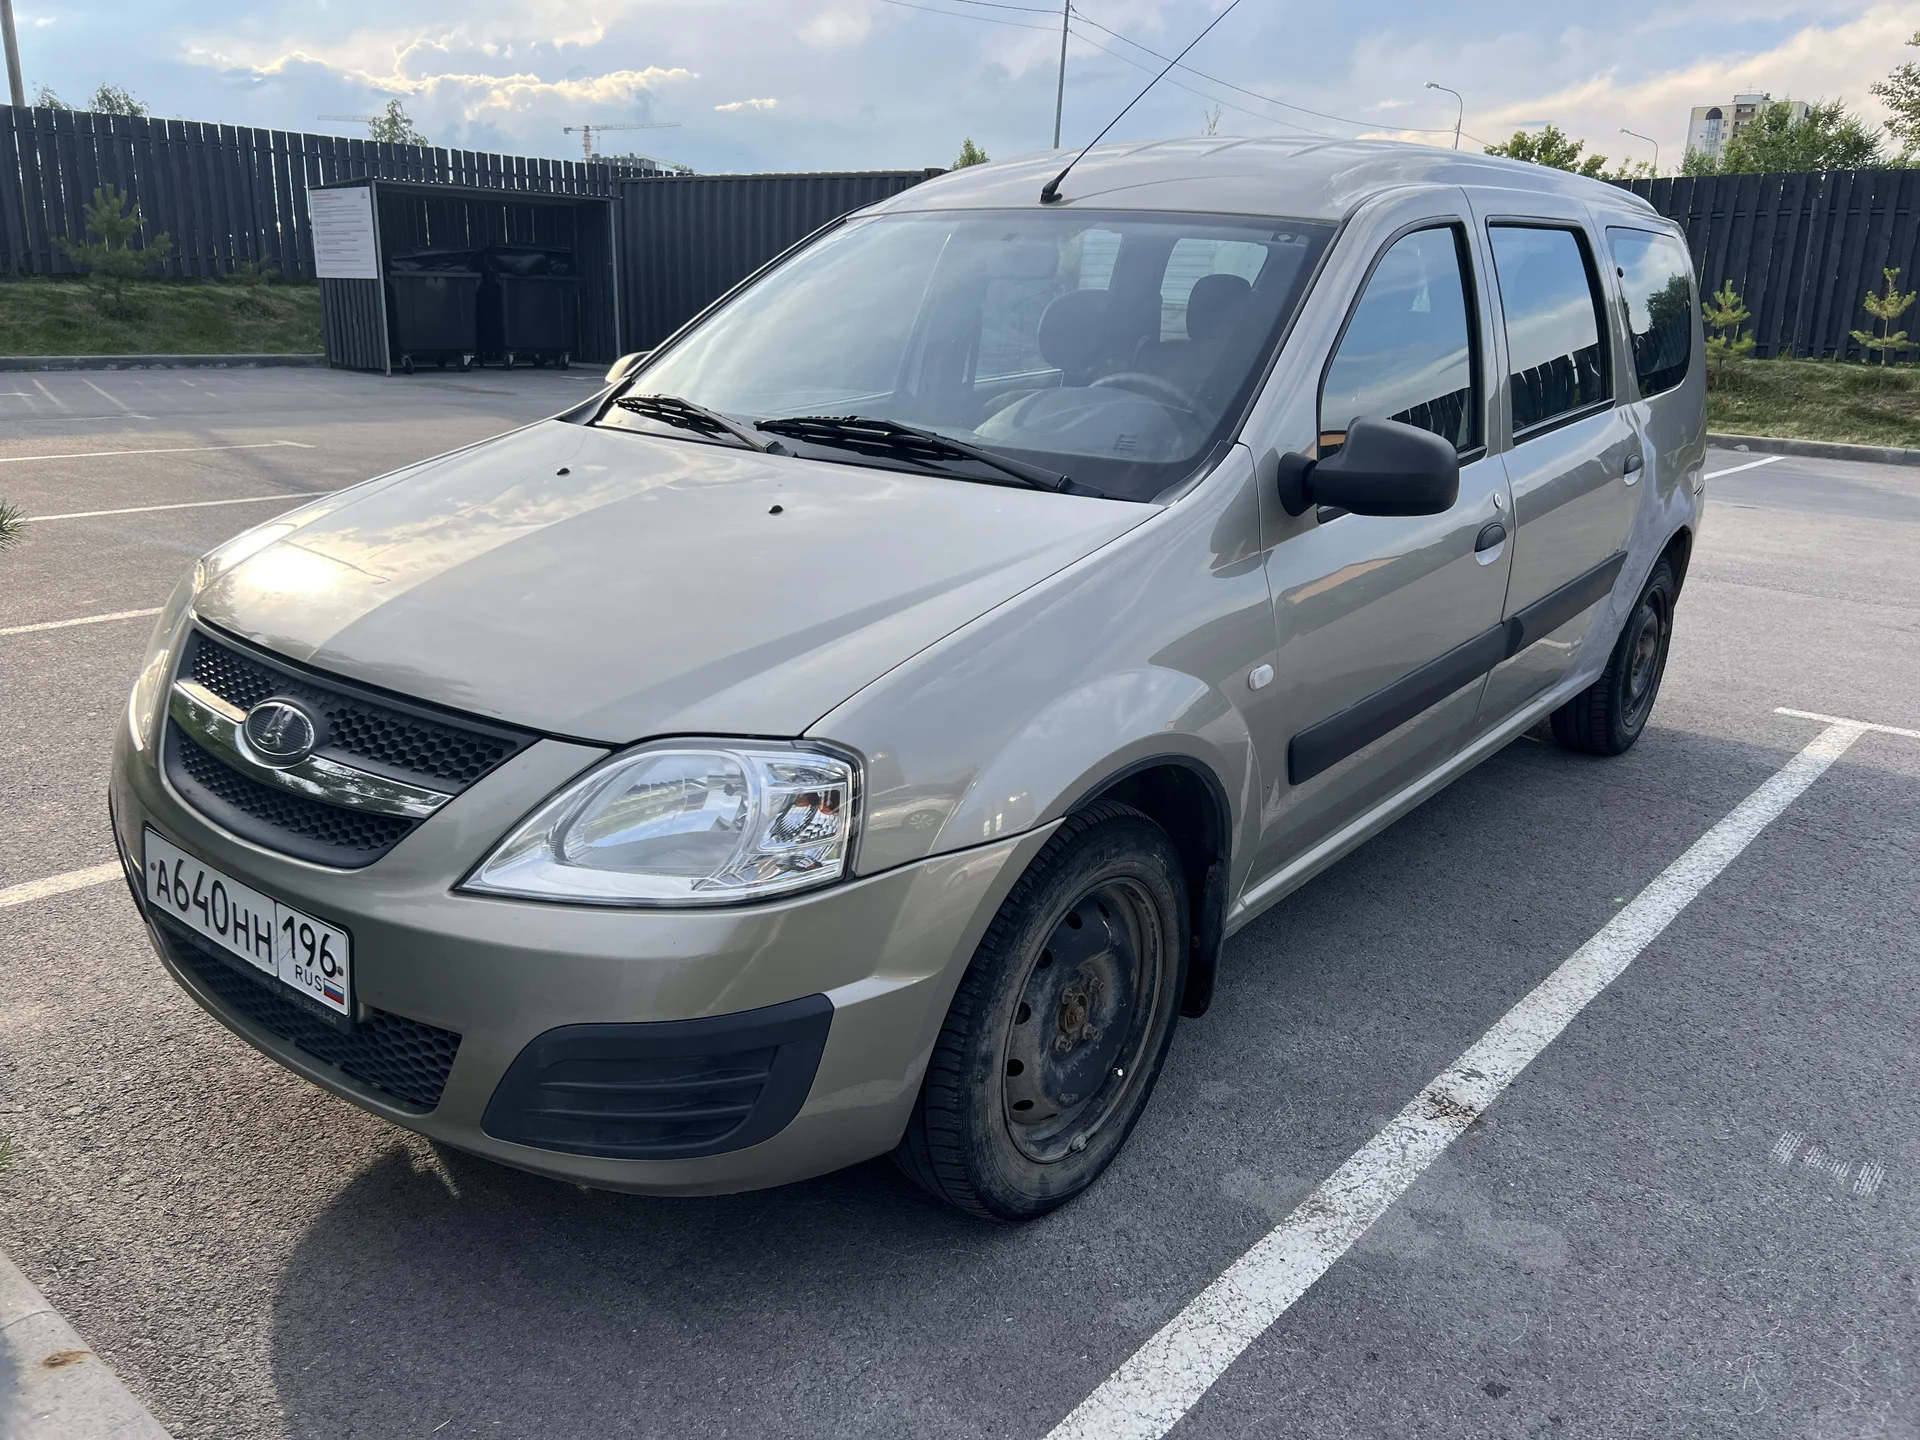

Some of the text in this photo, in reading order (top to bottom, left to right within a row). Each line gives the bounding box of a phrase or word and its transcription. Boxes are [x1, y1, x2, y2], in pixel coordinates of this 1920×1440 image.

[157, 858, 273, 964] А640НН
[282, 915, 337, 978] 196
[295, 964, 323, 992] RUS
